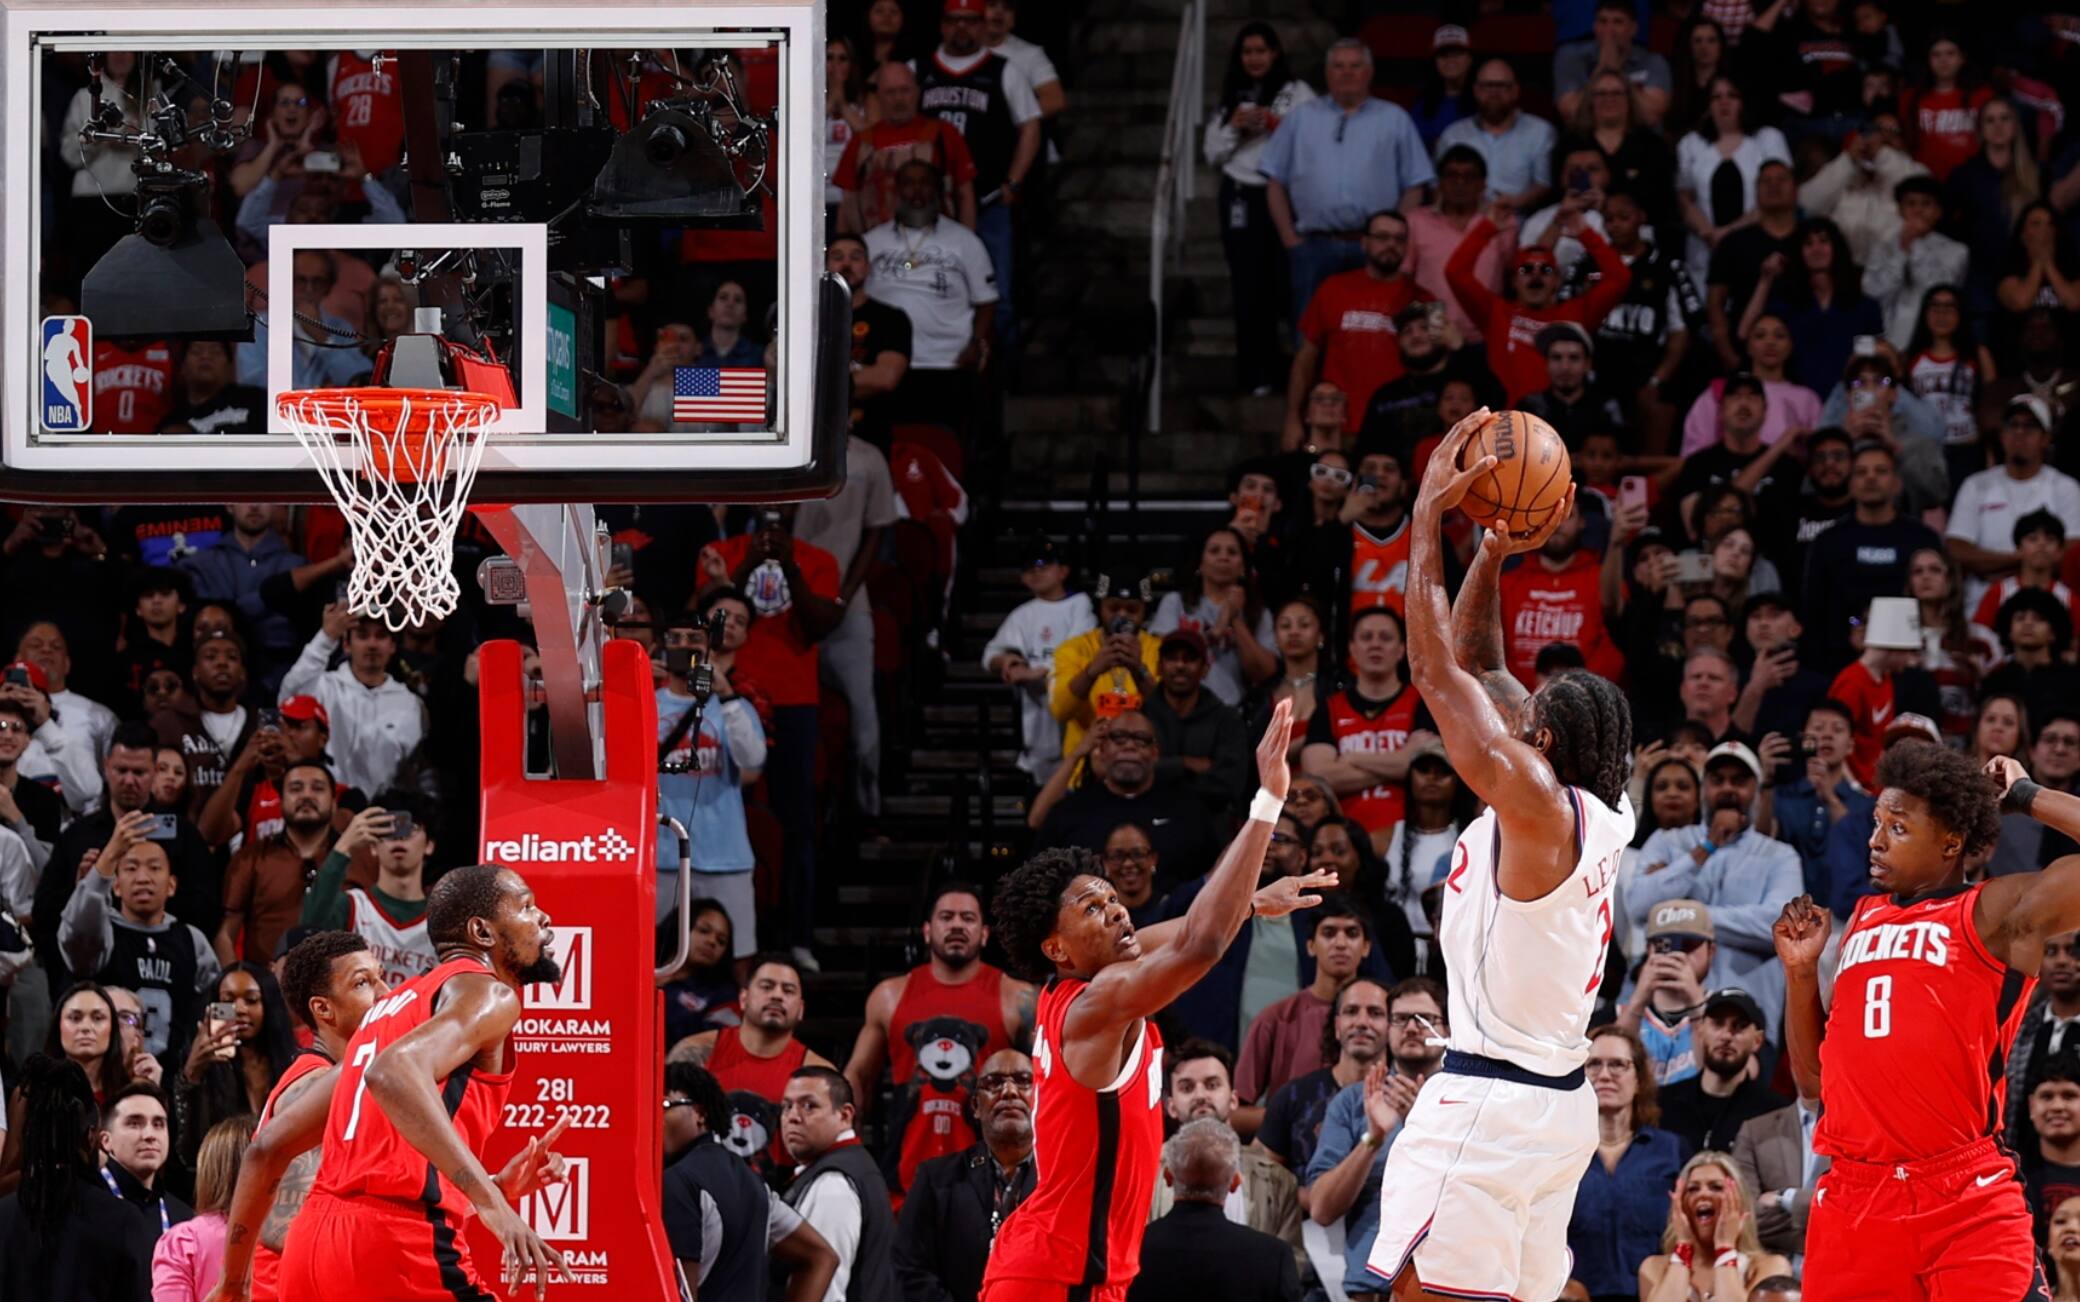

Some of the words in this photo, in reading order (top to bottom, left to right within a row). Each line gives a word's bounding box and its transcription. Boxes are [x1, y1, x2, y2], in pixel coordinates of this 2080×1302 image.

[347, 93, 373, 128] 28
[47, 404, 73, 425] NBA
[1352, 557, 1409, 597] LA
[1513, 608, 1584, 638] KETCHUP
[485, 833, 598, 863] reliant
[1655, 906, 1697, 928] Clips
[137, 956, 173, 985] PAUL
[369, 943, 437, 970] OCKETS
[1863, 974, 1893, 1040] 8
[551, 1042, 611, 1055] LAWYERS
[342, 1036, 378, 1142] 7
[536, 1077, 574, 1102] 281
[503, 1103, 611, 1129] 222-2222
[547, 1273, 609, 1285] LAYERS
